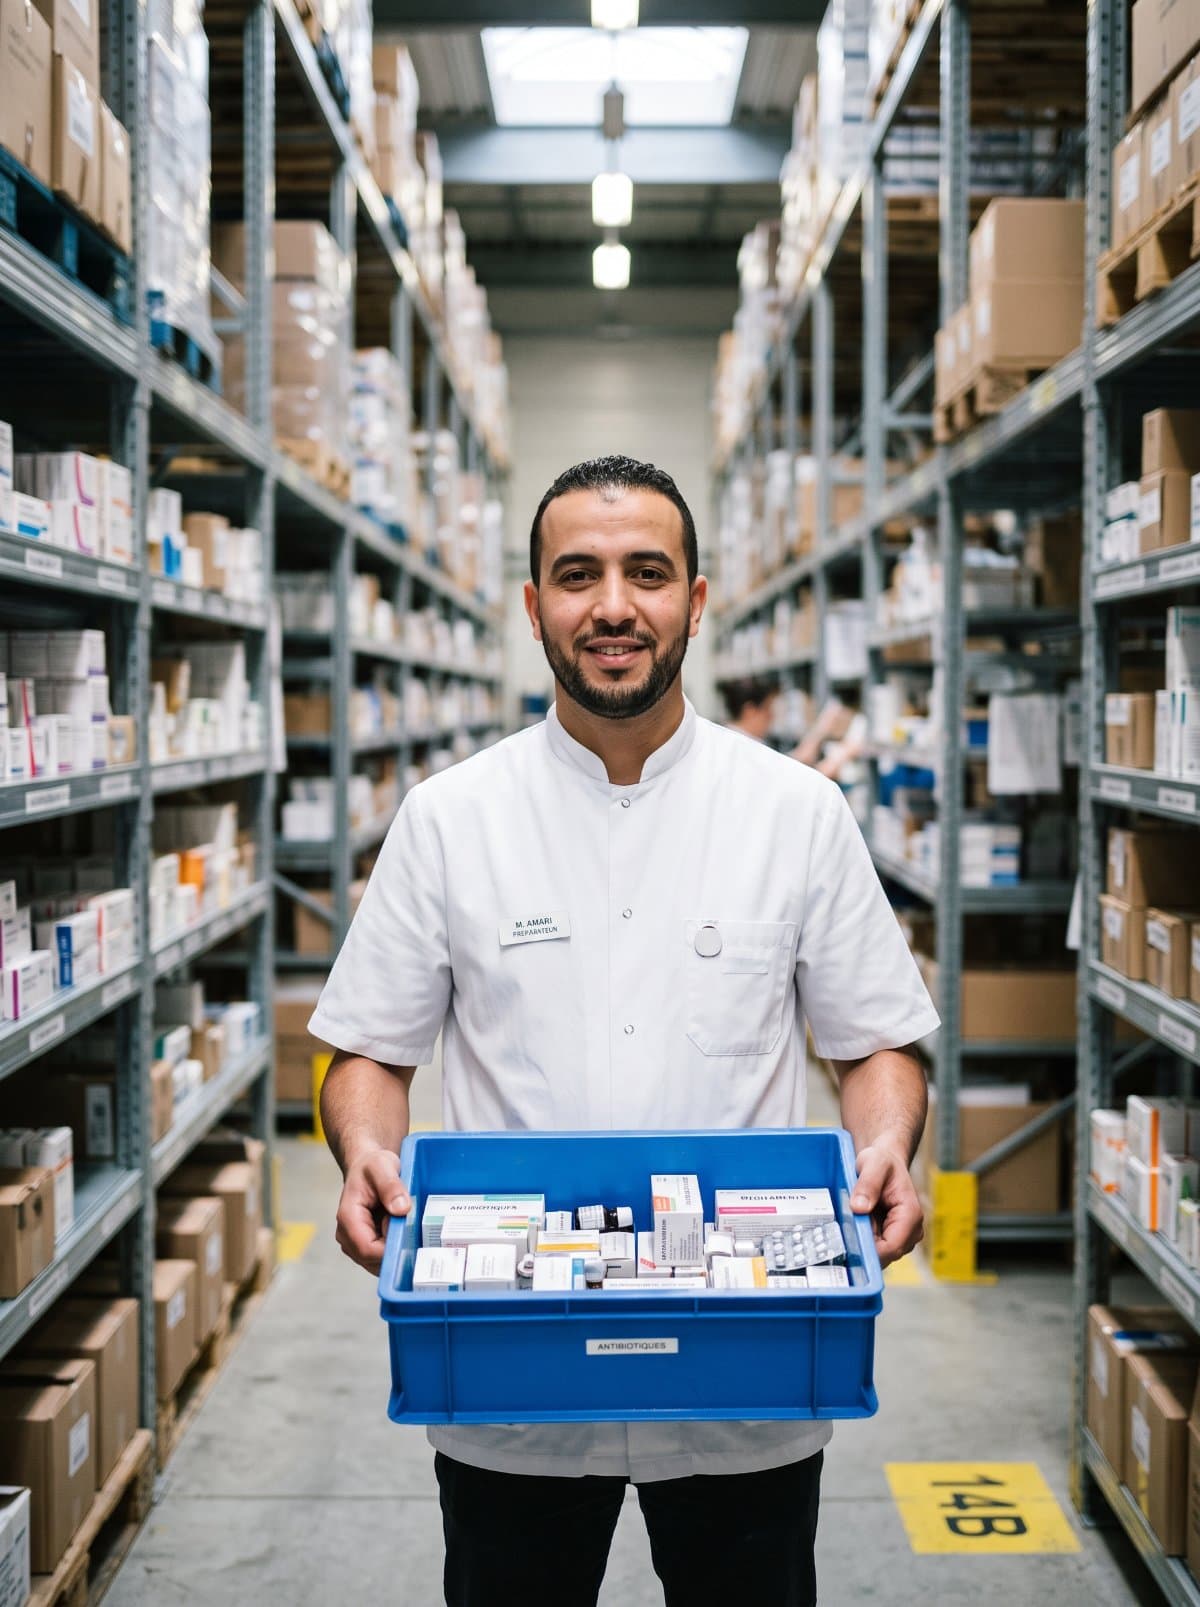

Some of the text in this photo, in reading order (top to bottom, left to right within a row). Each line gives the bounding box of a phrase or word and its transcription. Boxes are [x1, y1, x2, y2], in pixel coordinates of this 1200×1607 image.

[526, 917, 552, 926] AMARI
[597, 1342, 666, 1351] ANTIBIOTIQUES
[930, 1473, 1028, 1537] 14B
